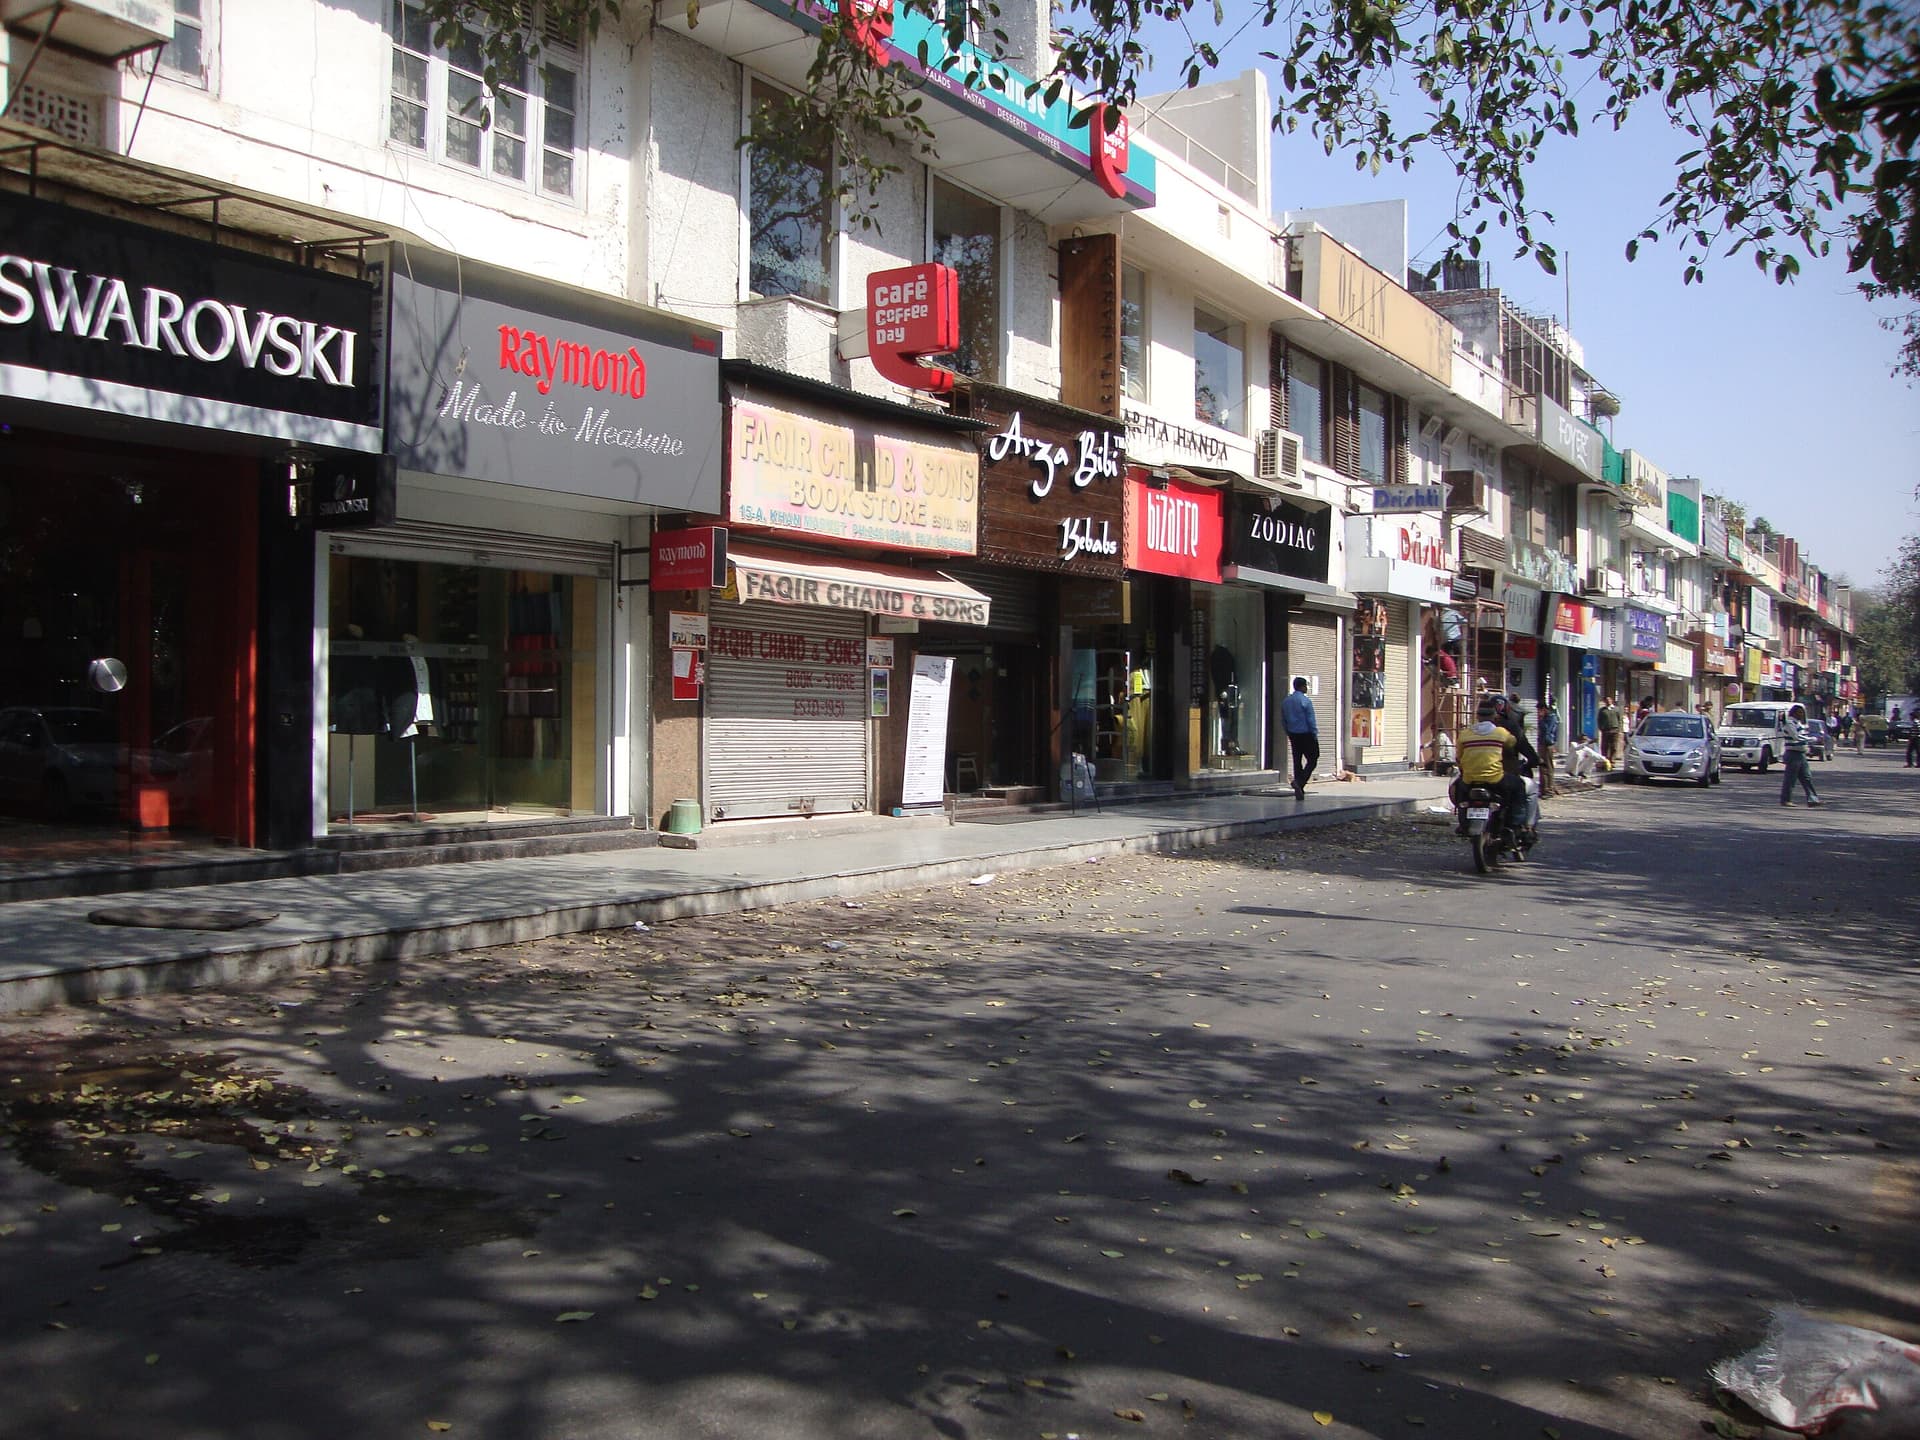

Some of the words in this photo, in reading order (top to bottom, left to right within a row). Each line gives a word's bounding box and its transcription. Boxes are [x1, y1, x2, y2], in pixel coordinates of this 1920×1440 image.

[926, 68, 951, 89] SALADS
[963, 88, 986, 110] PASTAS
[997, 107, 1028, 132] DESSERTS
[0, 254, 357, 388] SWAROVSKI
[497, 324, 646, 399] Raymond
[740, 415, 812, 473] FAQIR
[901, 455, 916, 492] &
[923, 461, 975, 502] SONS
[989, 411, 1069, 498] Arza
[1074, 430, 1118, 487] Bibi
[1177, 425, 1228, 461] HANDA
[769, 509, 801, 529] KHAN
[790, 477, 855, 516] BOOK
[861, 493, 928, 527] STORE
[1062, 517, 1117, 561] Kebabs
[1147, 492, 1199, 557] bizarre
[1251, 513, 1316, 552] ZODIAC
[746, 572, 818, 601] FAQIR
[826, 583, 904, 614] CHAND
[912, 595, 926, 615] &
[933, 597, 985, 622] SONS
[710, 626, 754, 659] FAQIR
[760, 630, 806, 661] CHAND
[825, 637, 861, 665] SONS
[785, 669, 814, 688] BOOK
[824, 671, 856, 690] STORE
